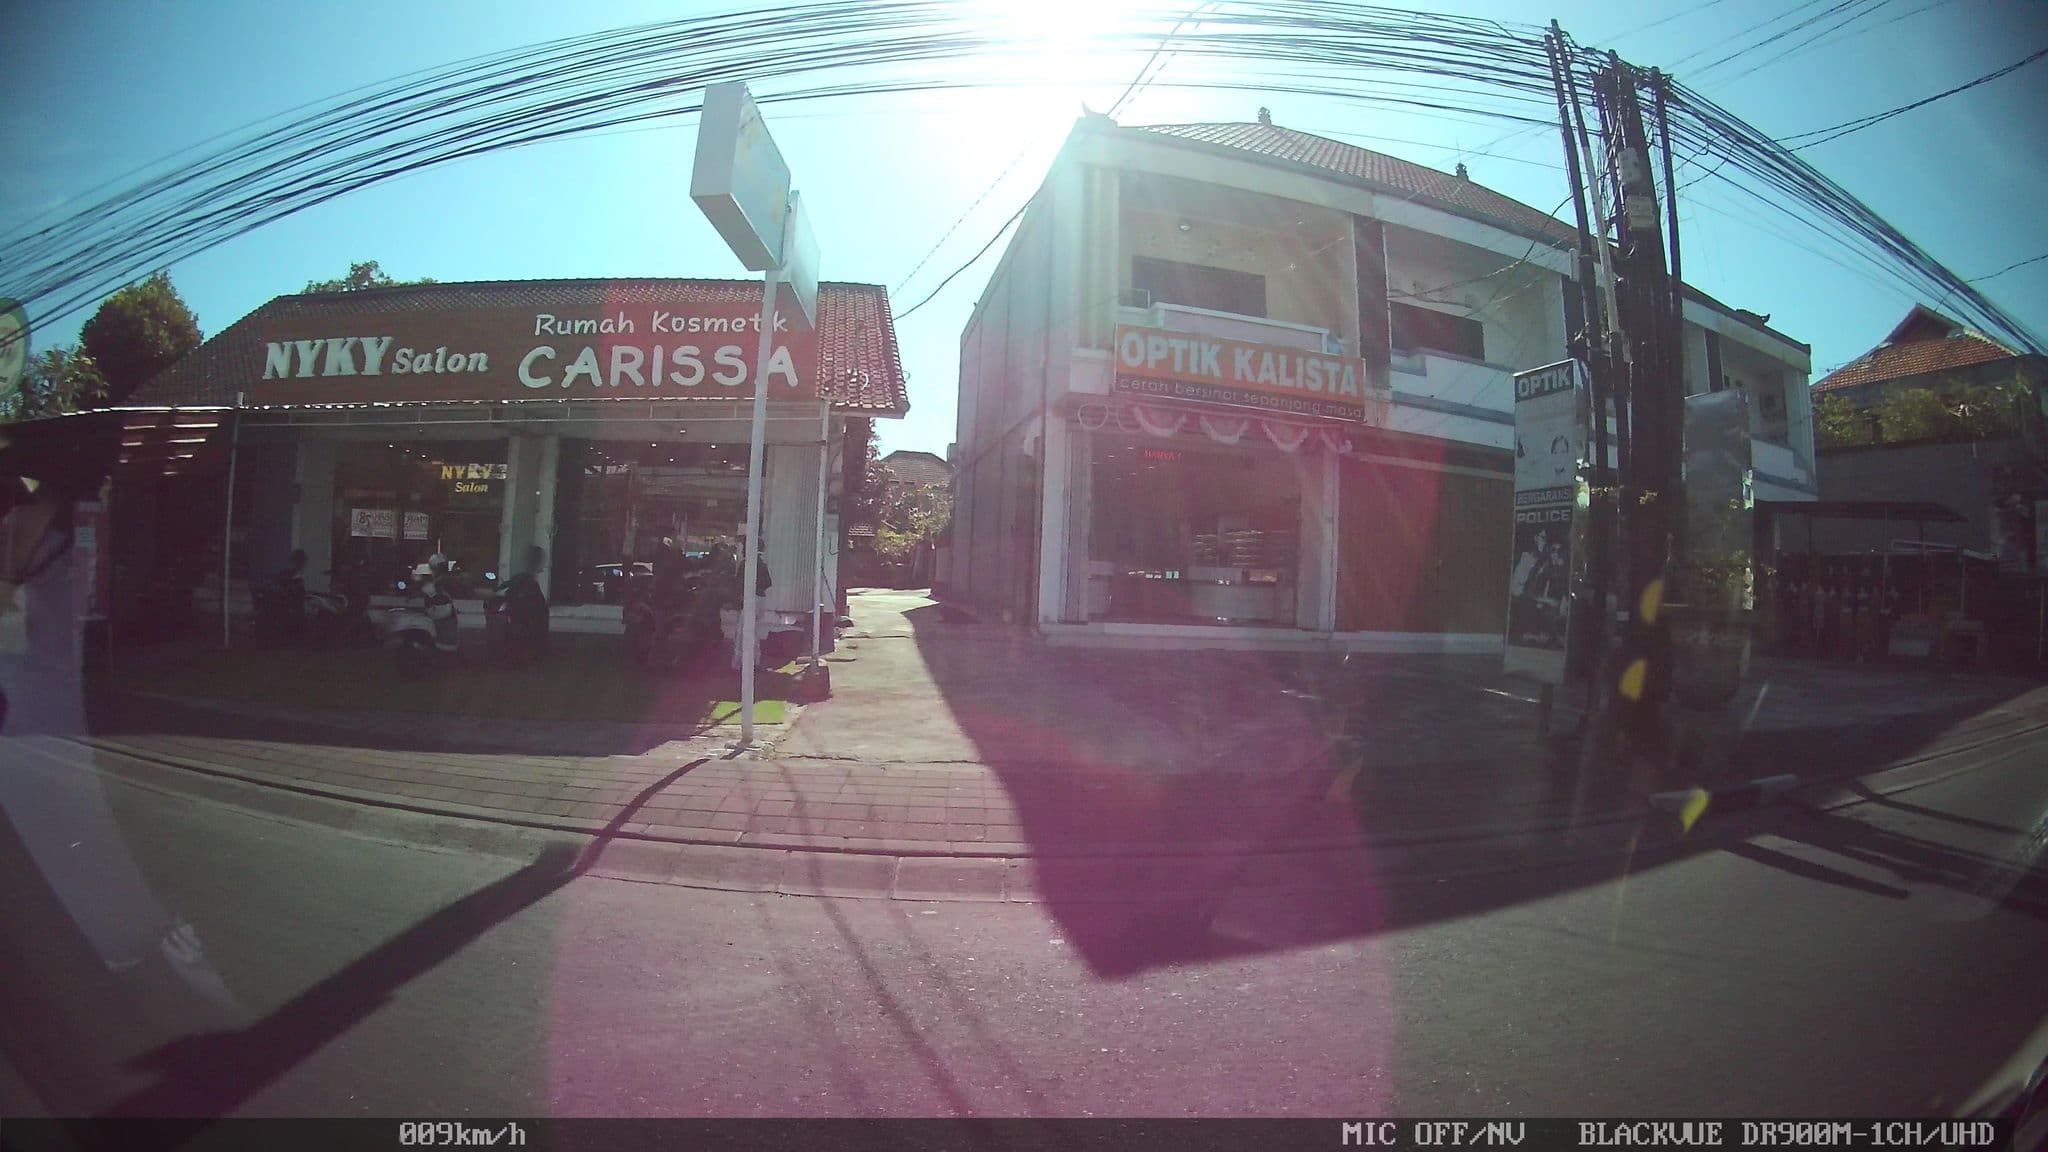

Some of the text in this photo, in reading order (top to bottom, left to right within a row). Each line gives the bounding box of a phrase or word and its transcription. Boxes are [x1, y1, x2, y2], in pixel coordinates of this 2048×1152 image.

[535, 310, 788, 336] Rumah Kosmetk
[262, 336, 489, 380] NYKY Salon
[518, 345, 799, 389] CARISSA
[1121, 331, 1359, 397] OPTIK KALISTA
[1518, 365, 1571, 398] OPTIK
[455, 481, 489, 493] Salon
[1516, 509, 1571, 524] POLICE
